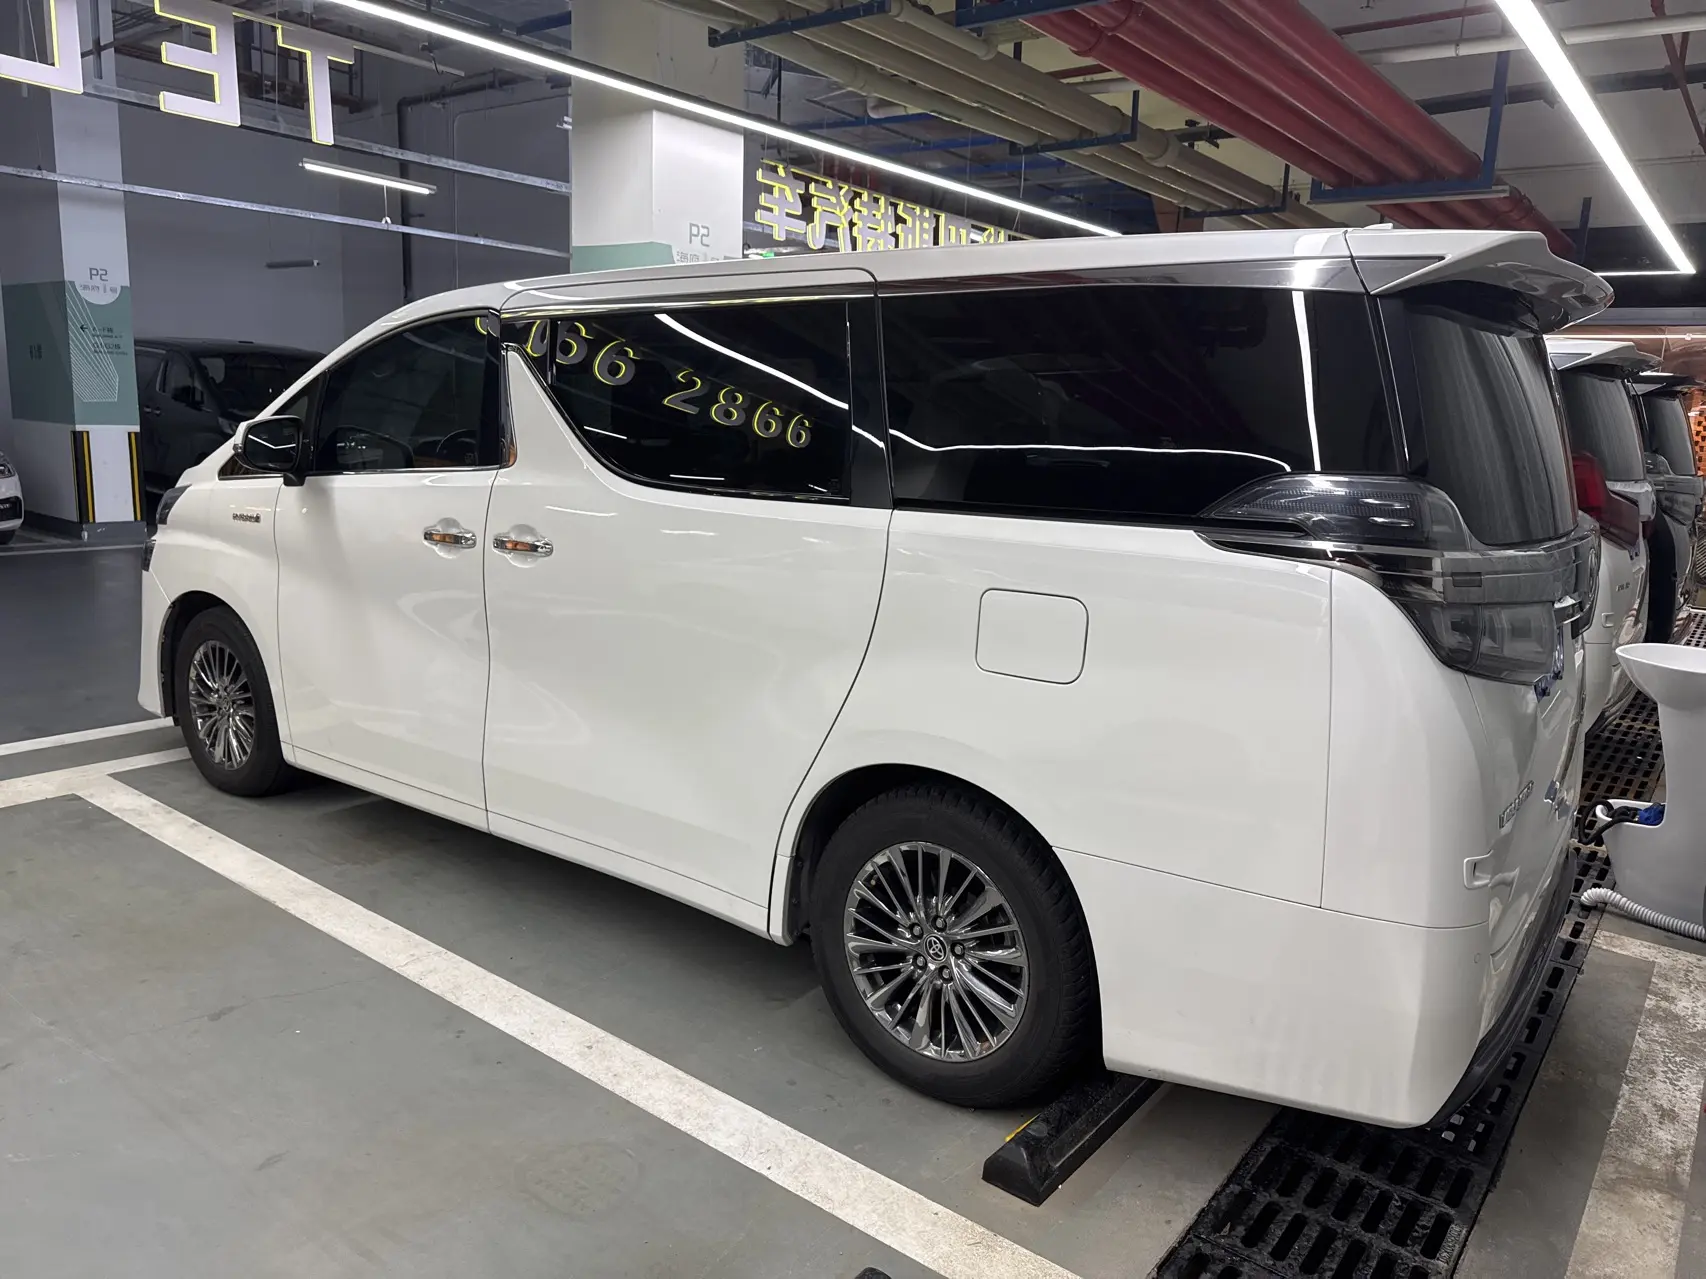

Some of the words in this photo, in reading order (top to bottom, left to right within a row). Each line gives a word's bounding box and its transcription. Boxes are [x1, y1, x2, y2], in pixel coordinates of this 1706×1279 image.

[688, 222, 710, 247] P2
[89, 267, 108, 281] P2
[661, 367, 813, 449] 2866
